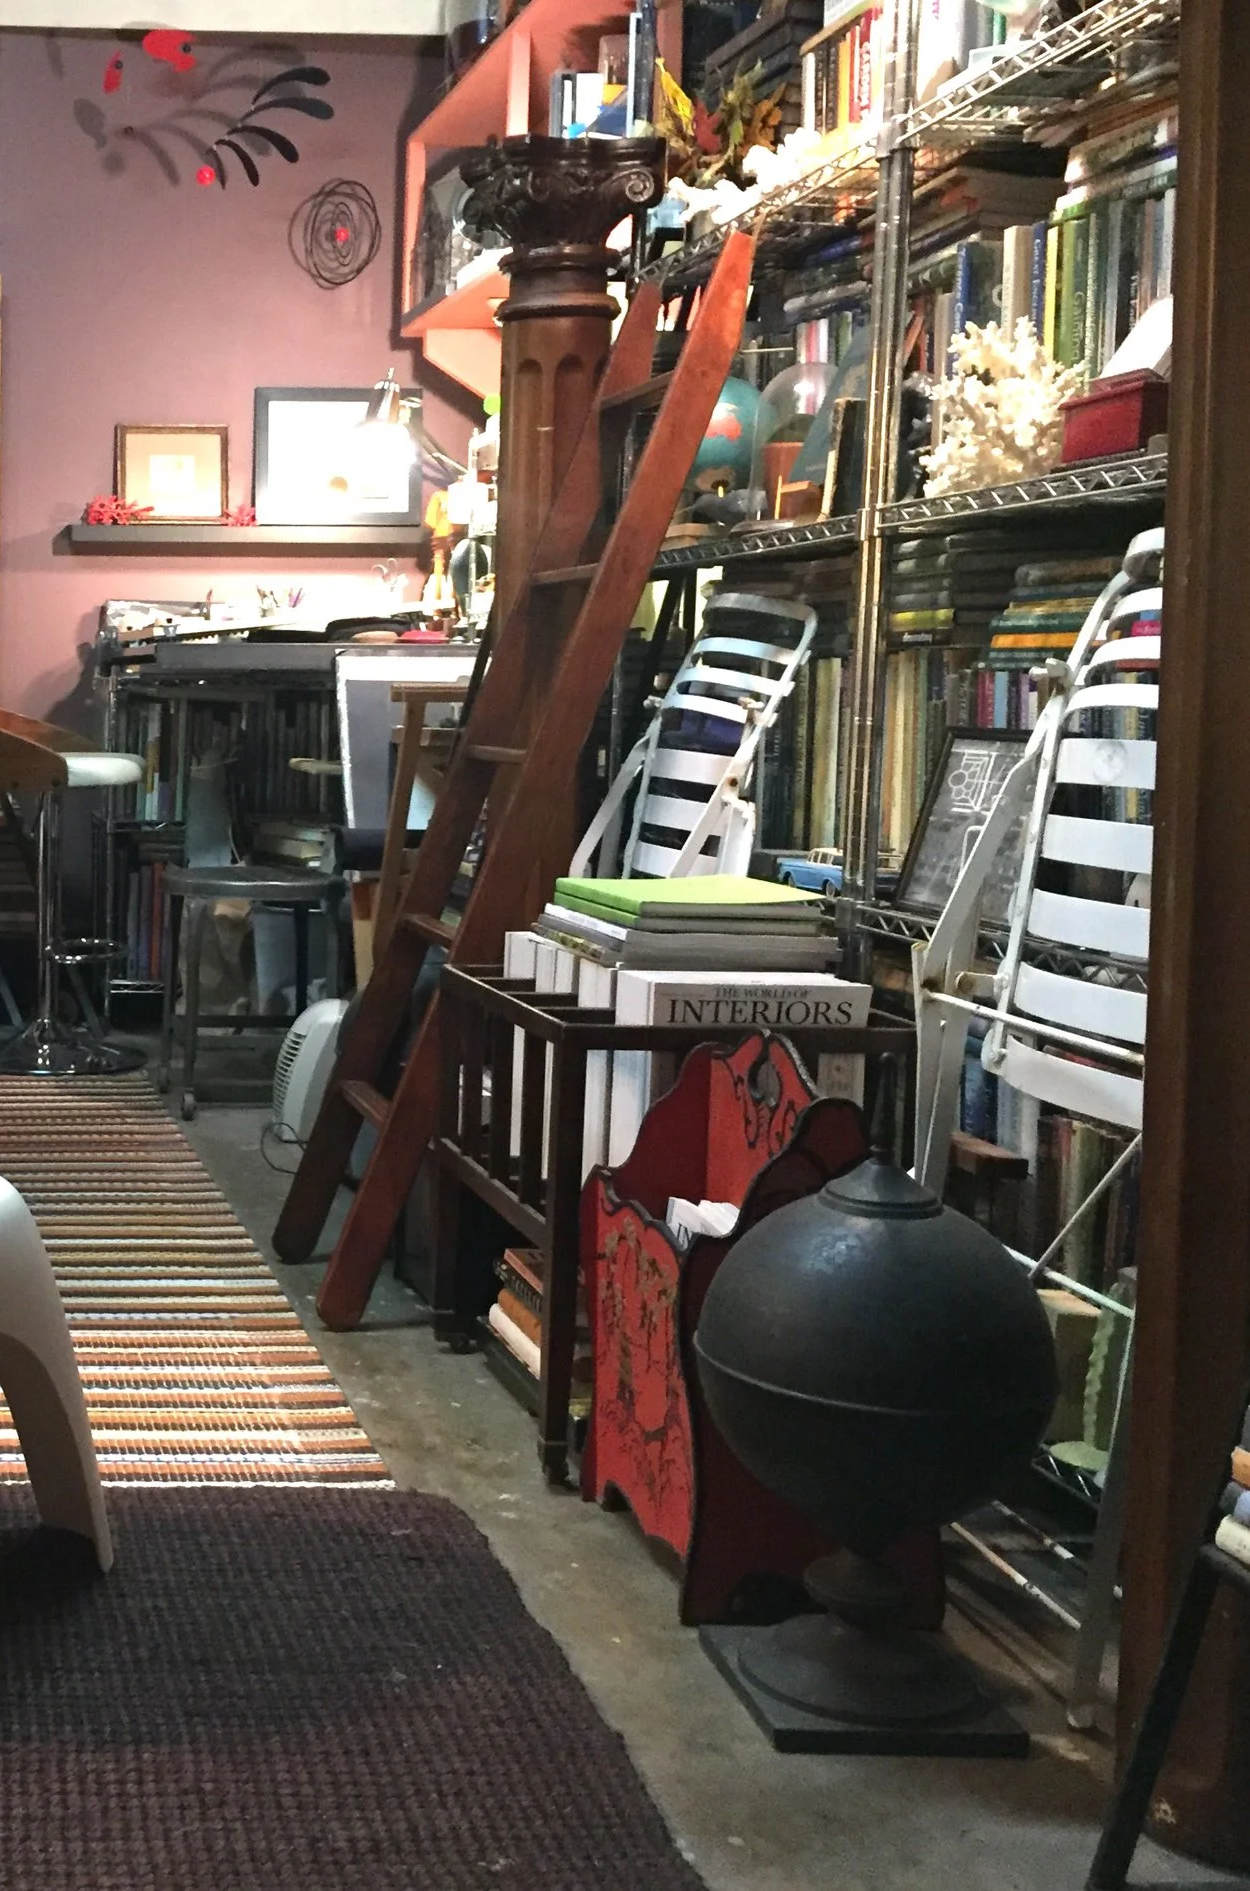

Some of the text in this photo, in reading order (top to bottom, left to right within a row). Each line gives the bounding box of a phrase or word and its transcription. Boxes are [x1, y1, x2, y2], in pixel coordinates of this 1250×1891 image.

[714, 987, 740, 999] THE
[743, 988, 790, 999] WORLD
[792, 988, 812, 999] OF
[668, 999, 853, 1025] INTERIORS
